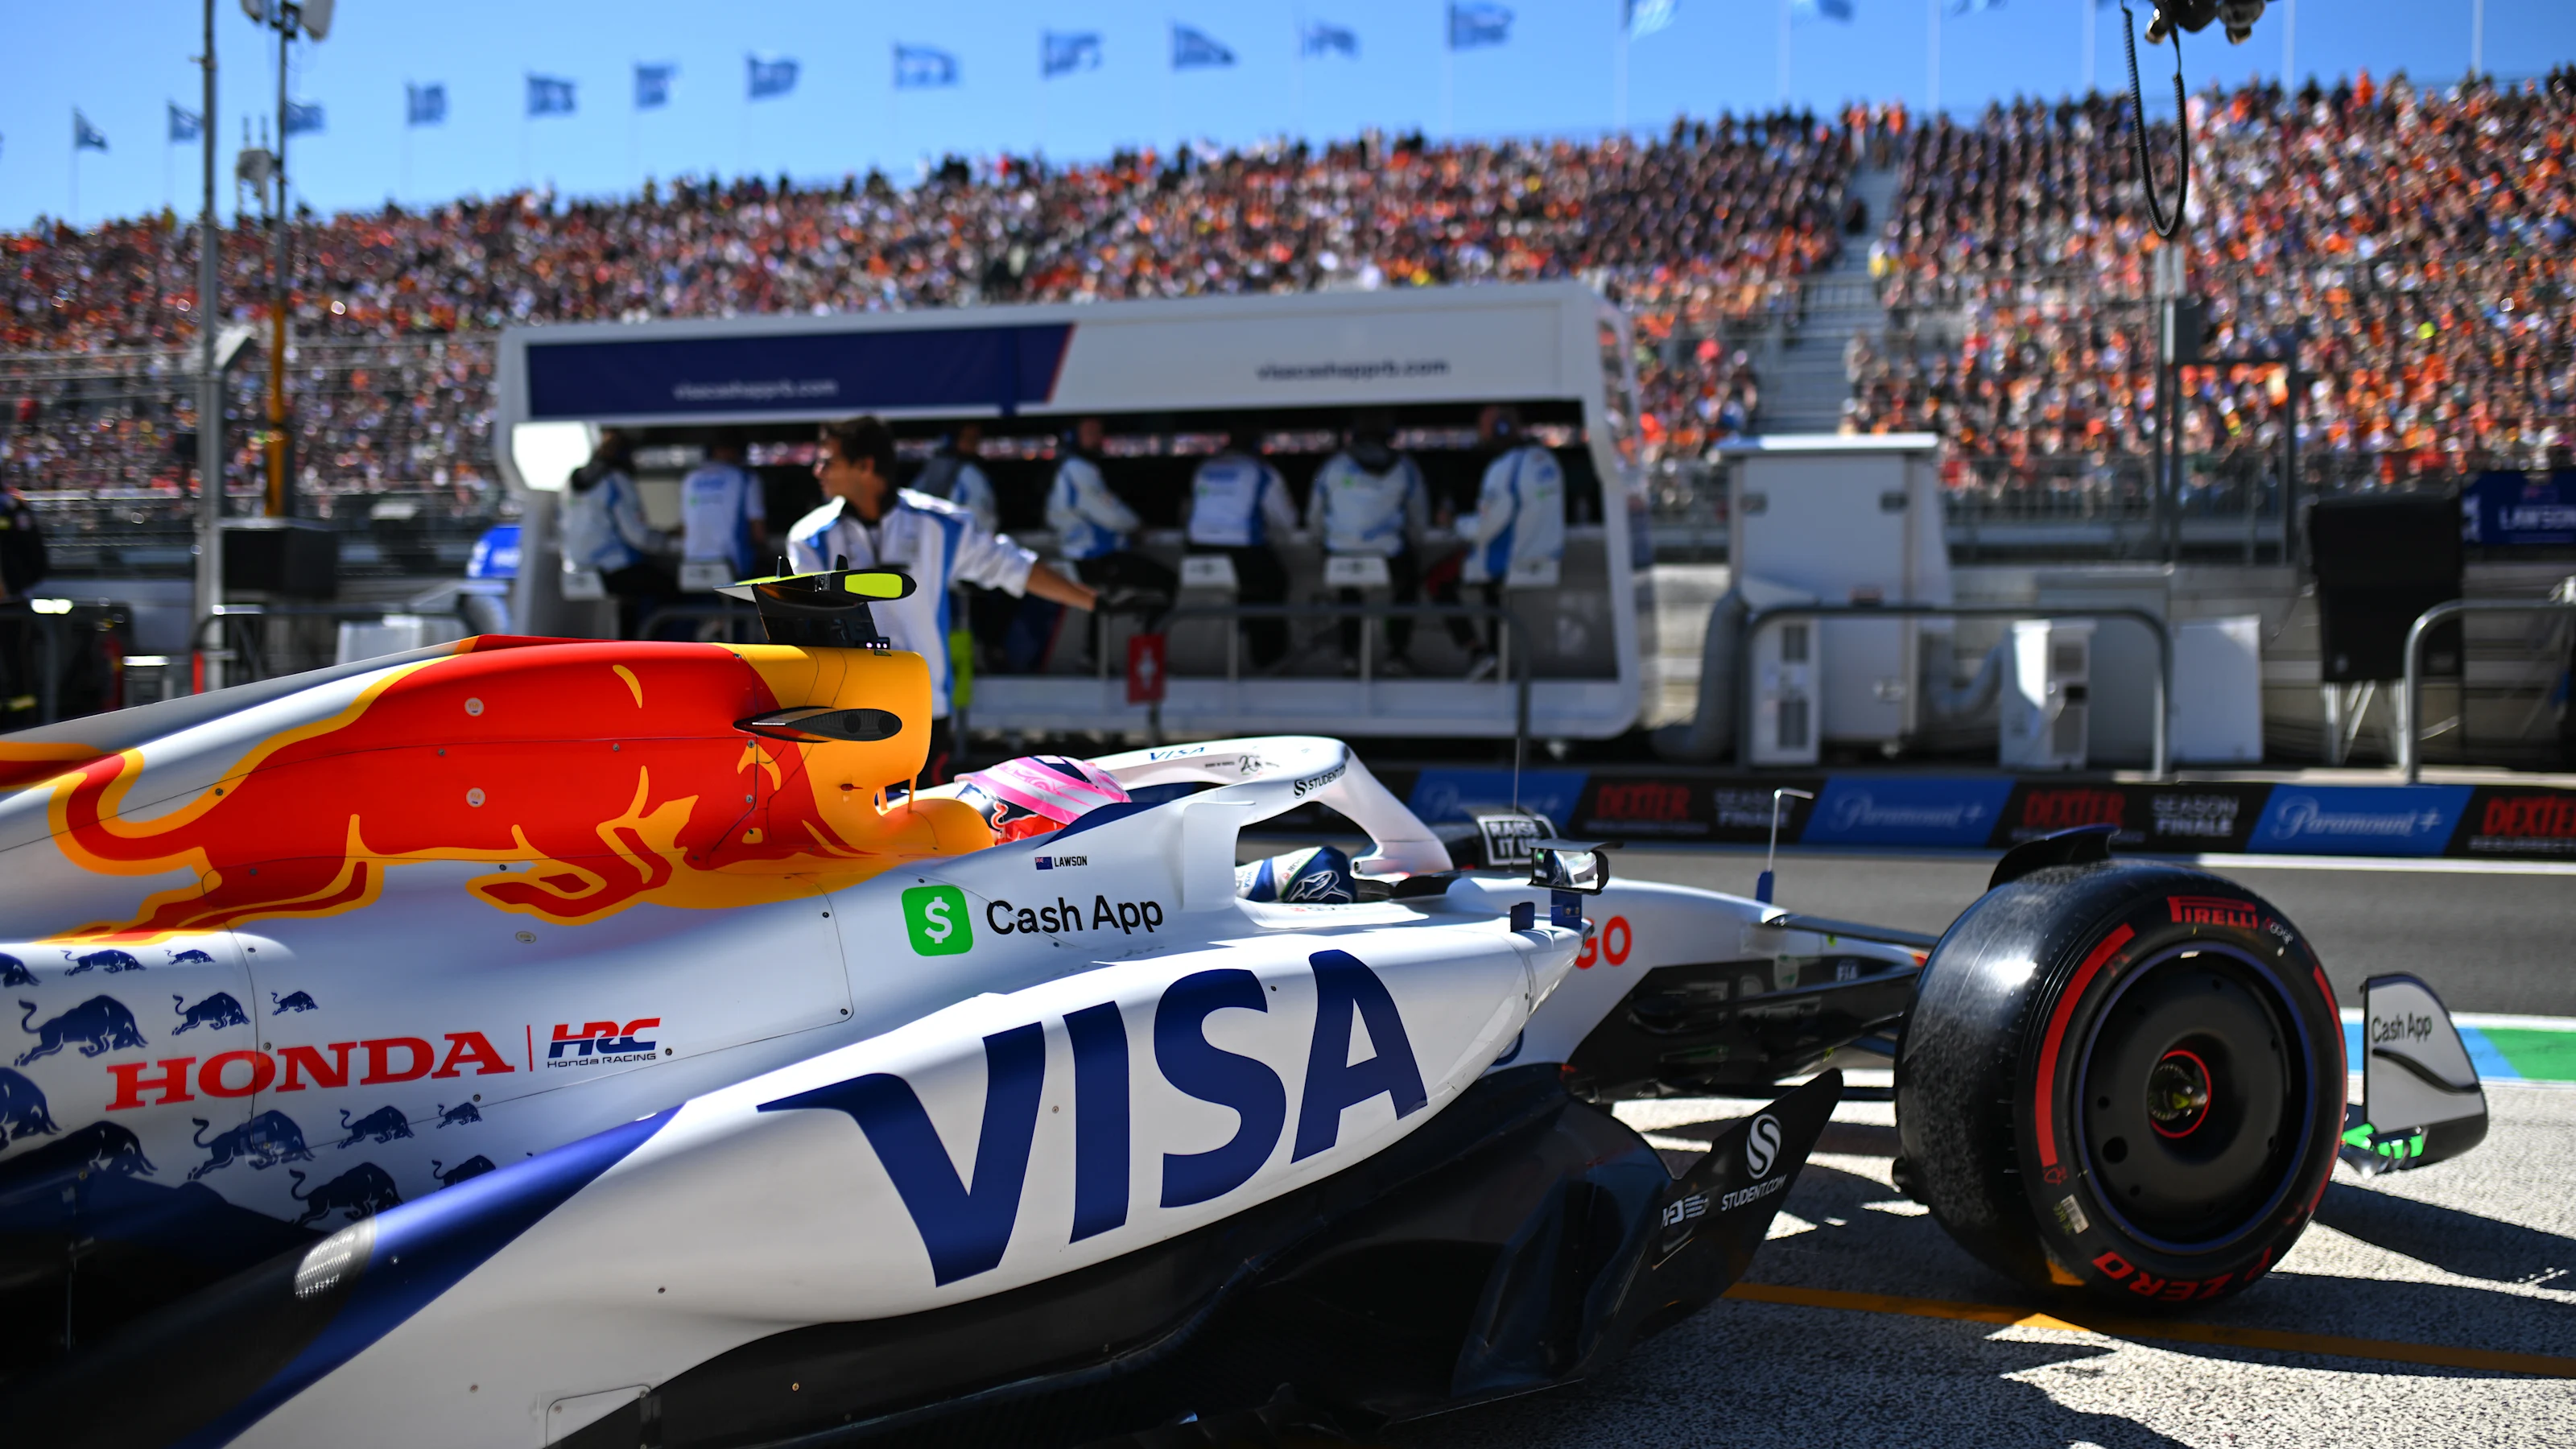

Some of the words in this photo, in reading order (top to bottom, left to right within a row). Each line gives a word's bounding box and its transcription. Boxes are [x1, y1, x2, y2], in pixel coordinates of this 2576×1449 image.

[1150, 746, 1204, 761] VISA
[2023, 788, 2126, 828] DEXTER
[2153, 794, 2240, 818] SEASON
[2271, 795, 2442, 840] Paramount+
[2483, 795, 2576, 836] DEXTE
[2154, 817, 2234, 836] FINALE
[1055, 856, 1088, 868] LAWSON
[986, 897, 1084, 935] Cash
[1092, 894, 1164, 935] App
[2167, 896, 2258, 929] PIRELLI
[548, 1018, 661, 1059] HRC
[2372, 1014, 2405, 1043] Cash
[2407, 1011, 2433, 1043] App
[105, 1031, 514, 1112] HONDA
[547, 1058, 599, 1068] Honda
[602, 1053, 657, 1064] RACING
[756, 948, 1428, 1288] VISA
[1720, 1174, 1788, 1212] STUDENT.COM
[2093, 1251, 2234, 1301] ZERO
